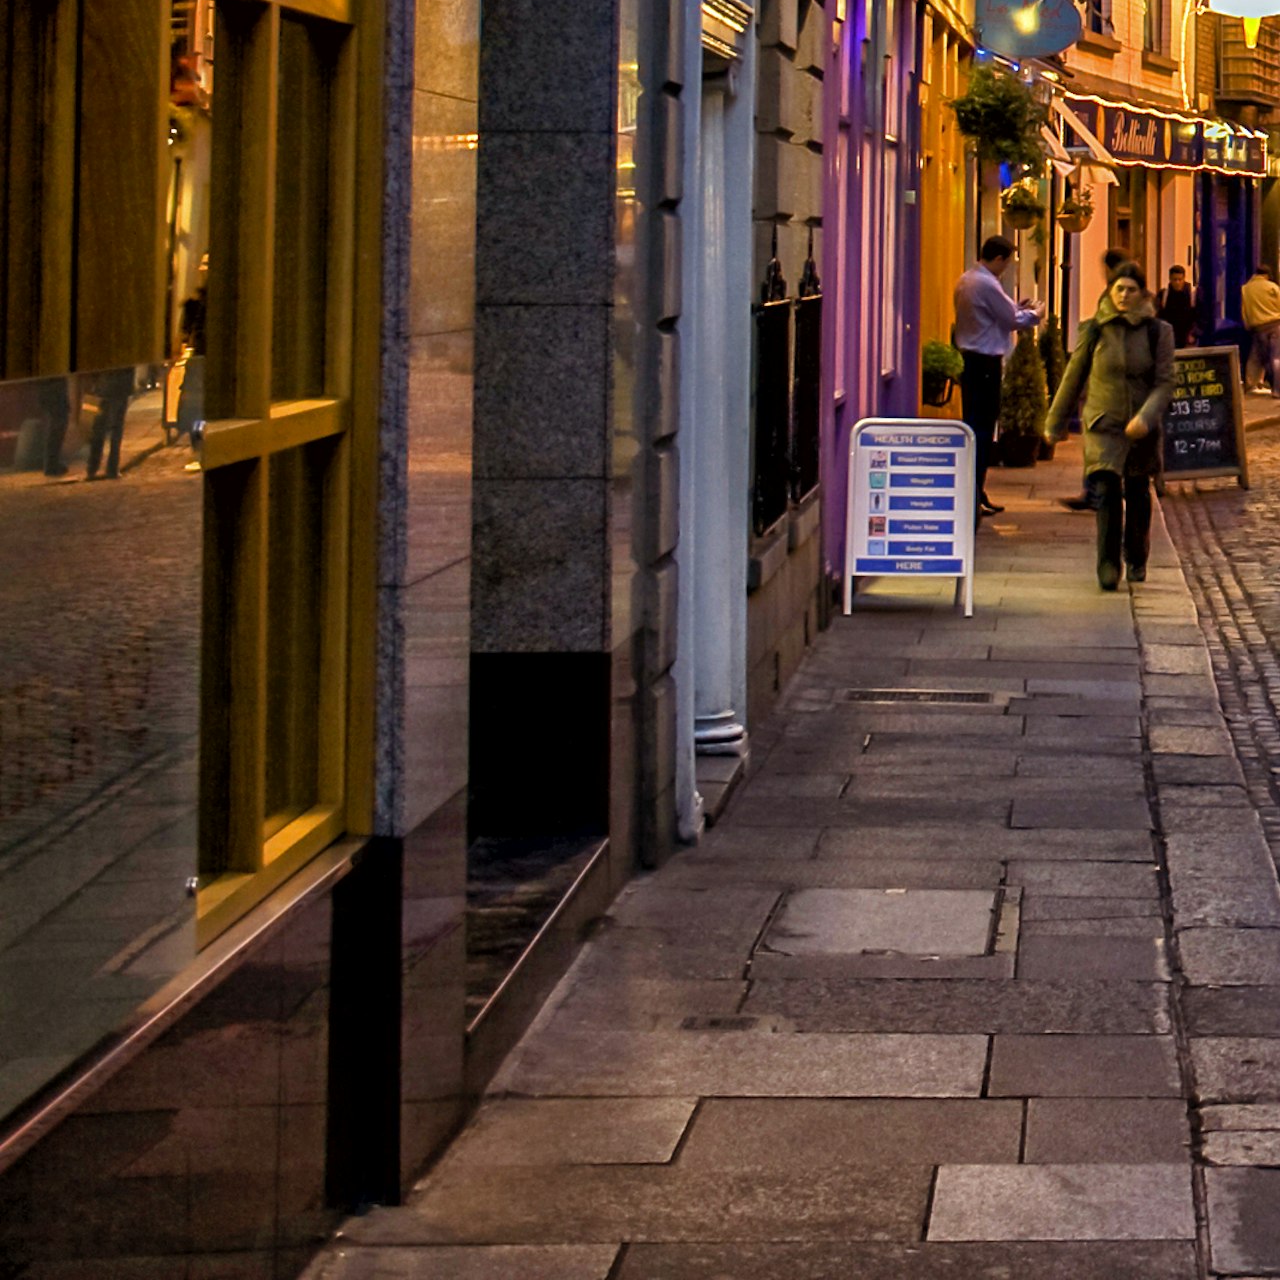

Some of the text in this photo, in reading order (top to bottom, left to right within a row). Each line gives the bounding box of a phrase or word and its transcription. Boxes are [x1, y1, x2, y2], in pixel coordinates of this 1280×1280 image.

[874, 435, 952, 445] HEALTH CHECK
[896, 561, 923, 570] HERE
